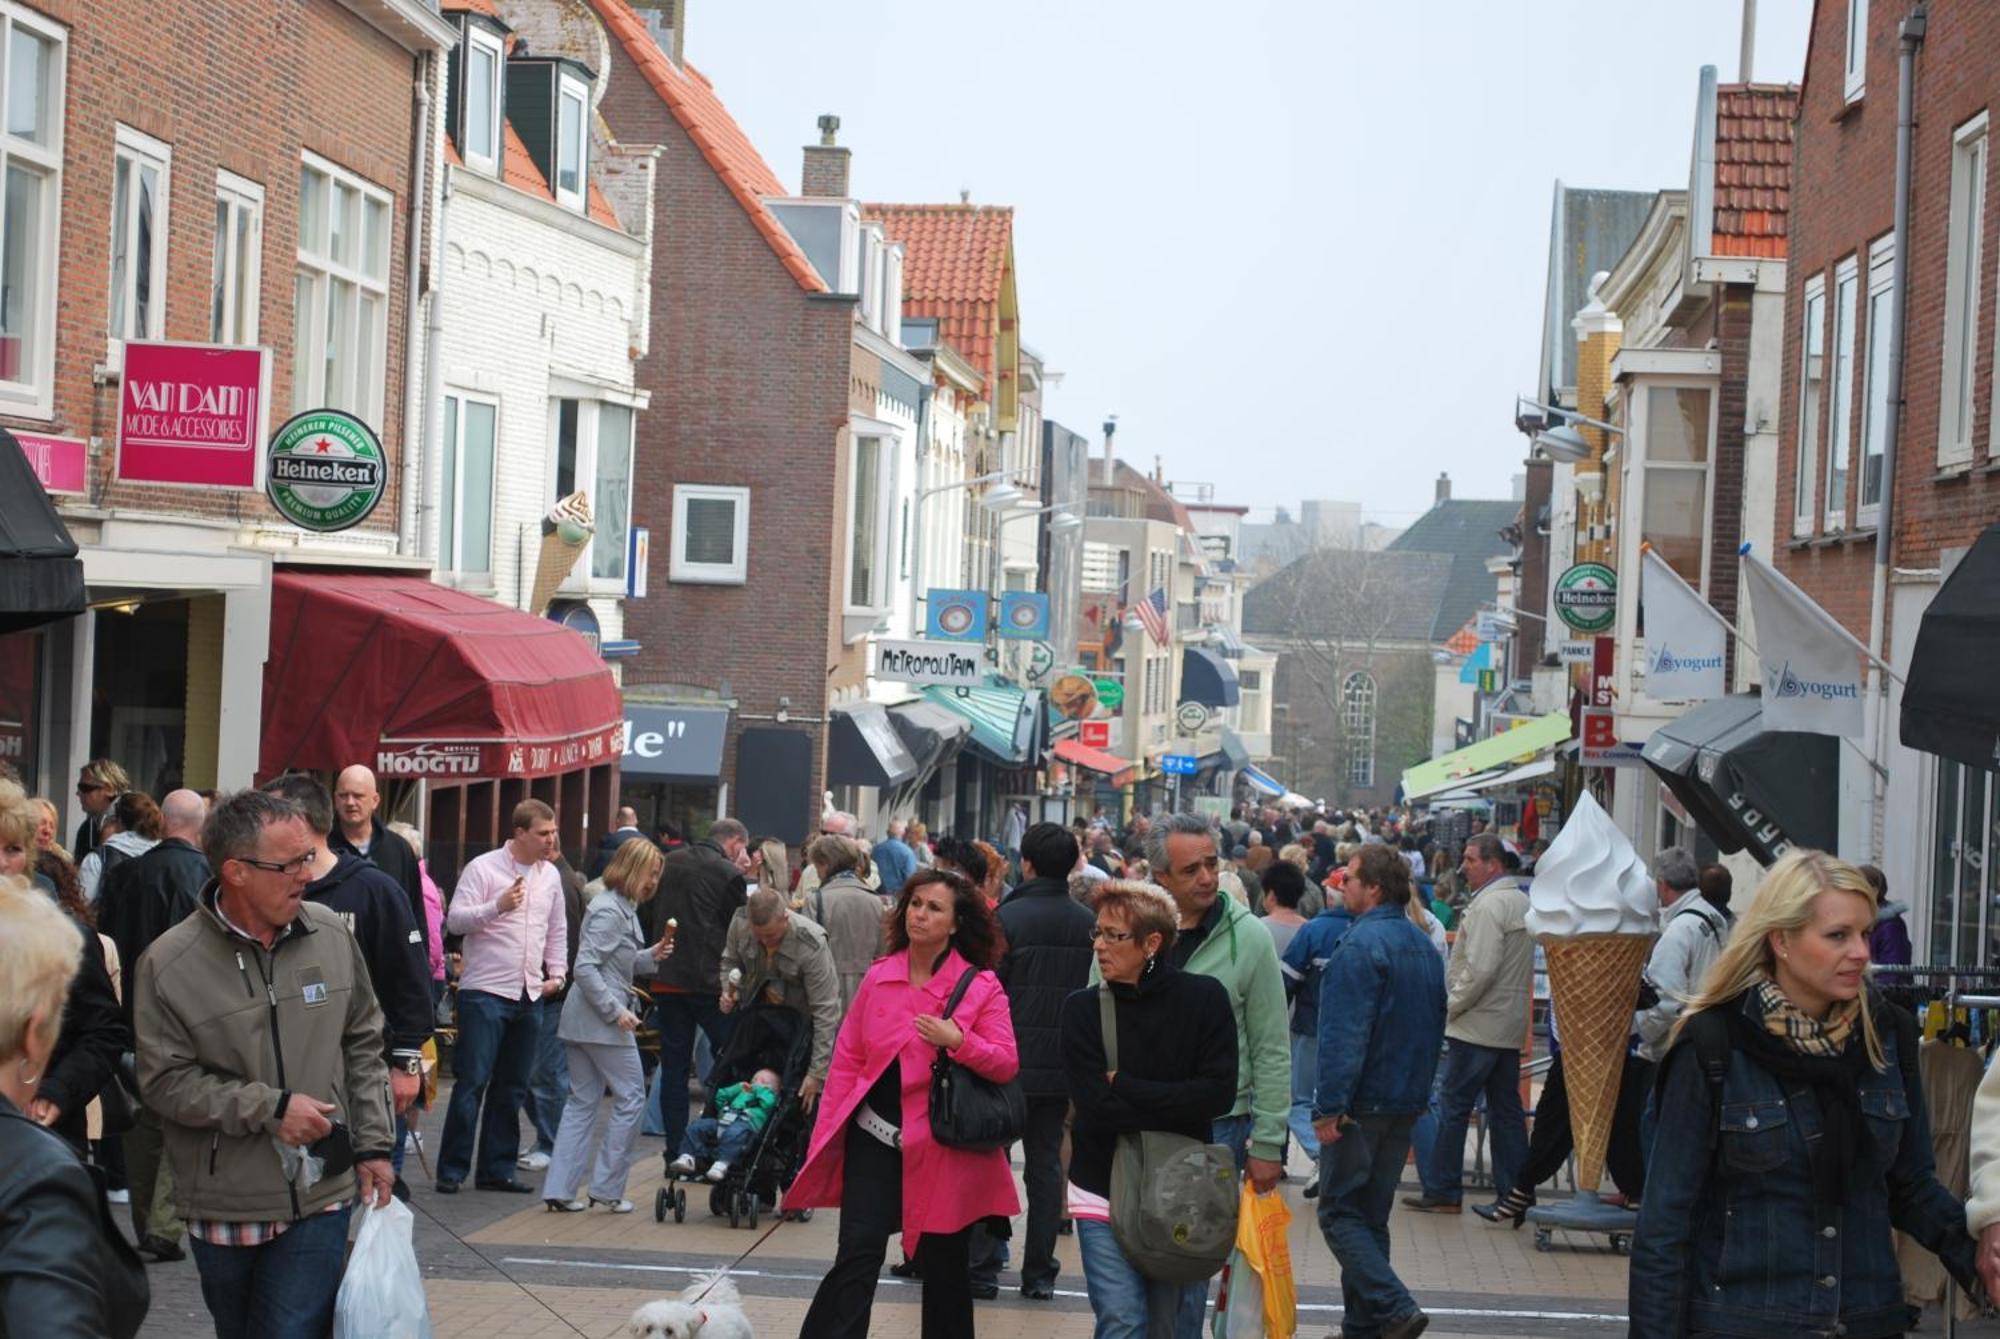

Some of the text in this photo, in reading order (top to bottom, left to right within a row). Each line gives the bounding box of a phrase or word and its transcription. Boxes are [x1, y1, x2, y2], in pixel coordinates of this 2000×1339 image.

[129, 380, 243, 416] VAN DAM
[126, 414, 159, 436] MODE
[170, 416, 242, 440] ACCESSOIRES
[284, 421, 366, 449] HEINEKEN PILSENER
[276, 459, 371, 482] Heineken
[282, 491, 363, 521] PREMIUM QUALITY
[1674, 655, 1722, 672] yogurt
[1801, 679, 1857, 701] yogurt
